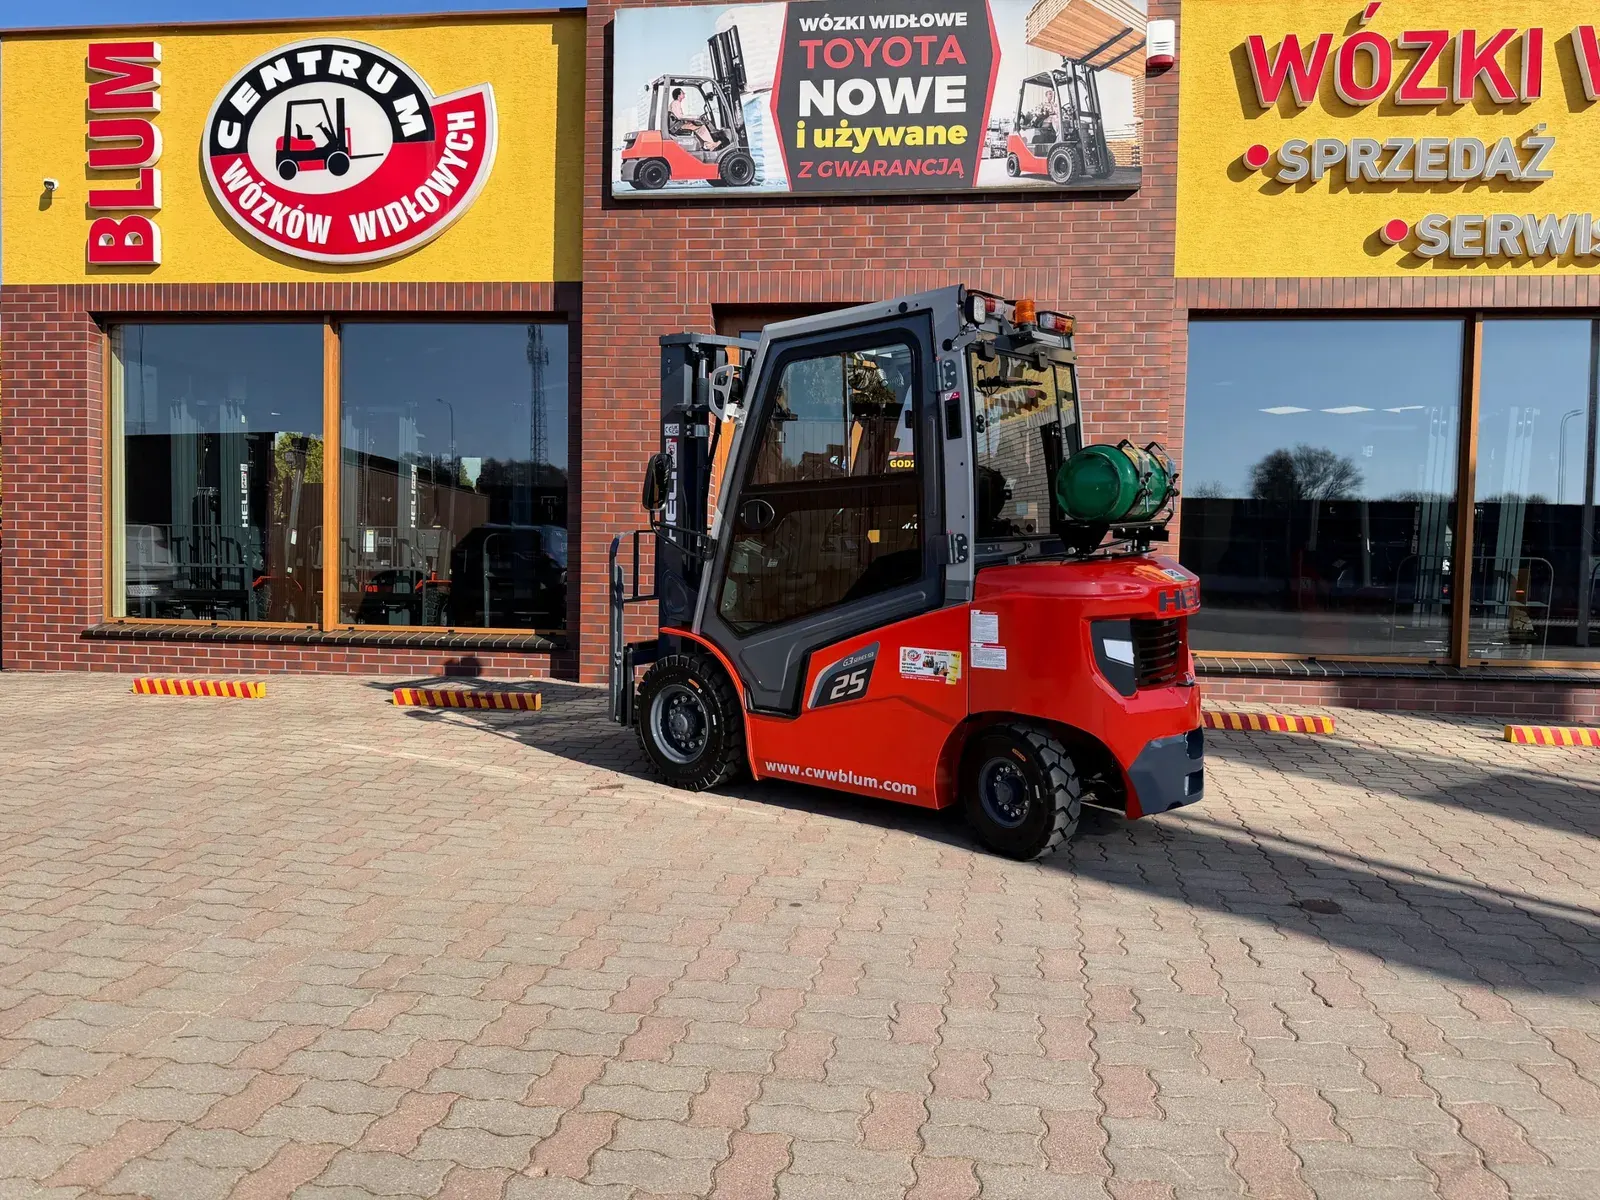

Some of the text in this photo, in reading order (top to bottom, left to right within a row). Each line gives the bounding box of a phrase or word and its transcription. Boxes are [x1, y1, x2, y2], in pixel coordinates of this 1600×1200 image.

[799, 11, 968, 31] WÓZKI WIDŁOWE
[799, 35, 968, 70] TOYOTA
[1245, 2, 1543, 108] WÓZKI
[217, 49, 427, 149] CENTRUM
[800, 76, 968, 117] NOWE
[88, 41, 161, 264] BLUM
[797, 119, 968, 154] i używane
[1277, 123, 1555, 183] SPRZEDAŻ
[220, 109, 476, 245] WÓZKÓW WIDŁOWYCH
[797, 156, 965, 180] Z GWARANCJĄ
[830, 668, 868, 700] 25
[765, 761, 917, 796] www.cwwblum.com
